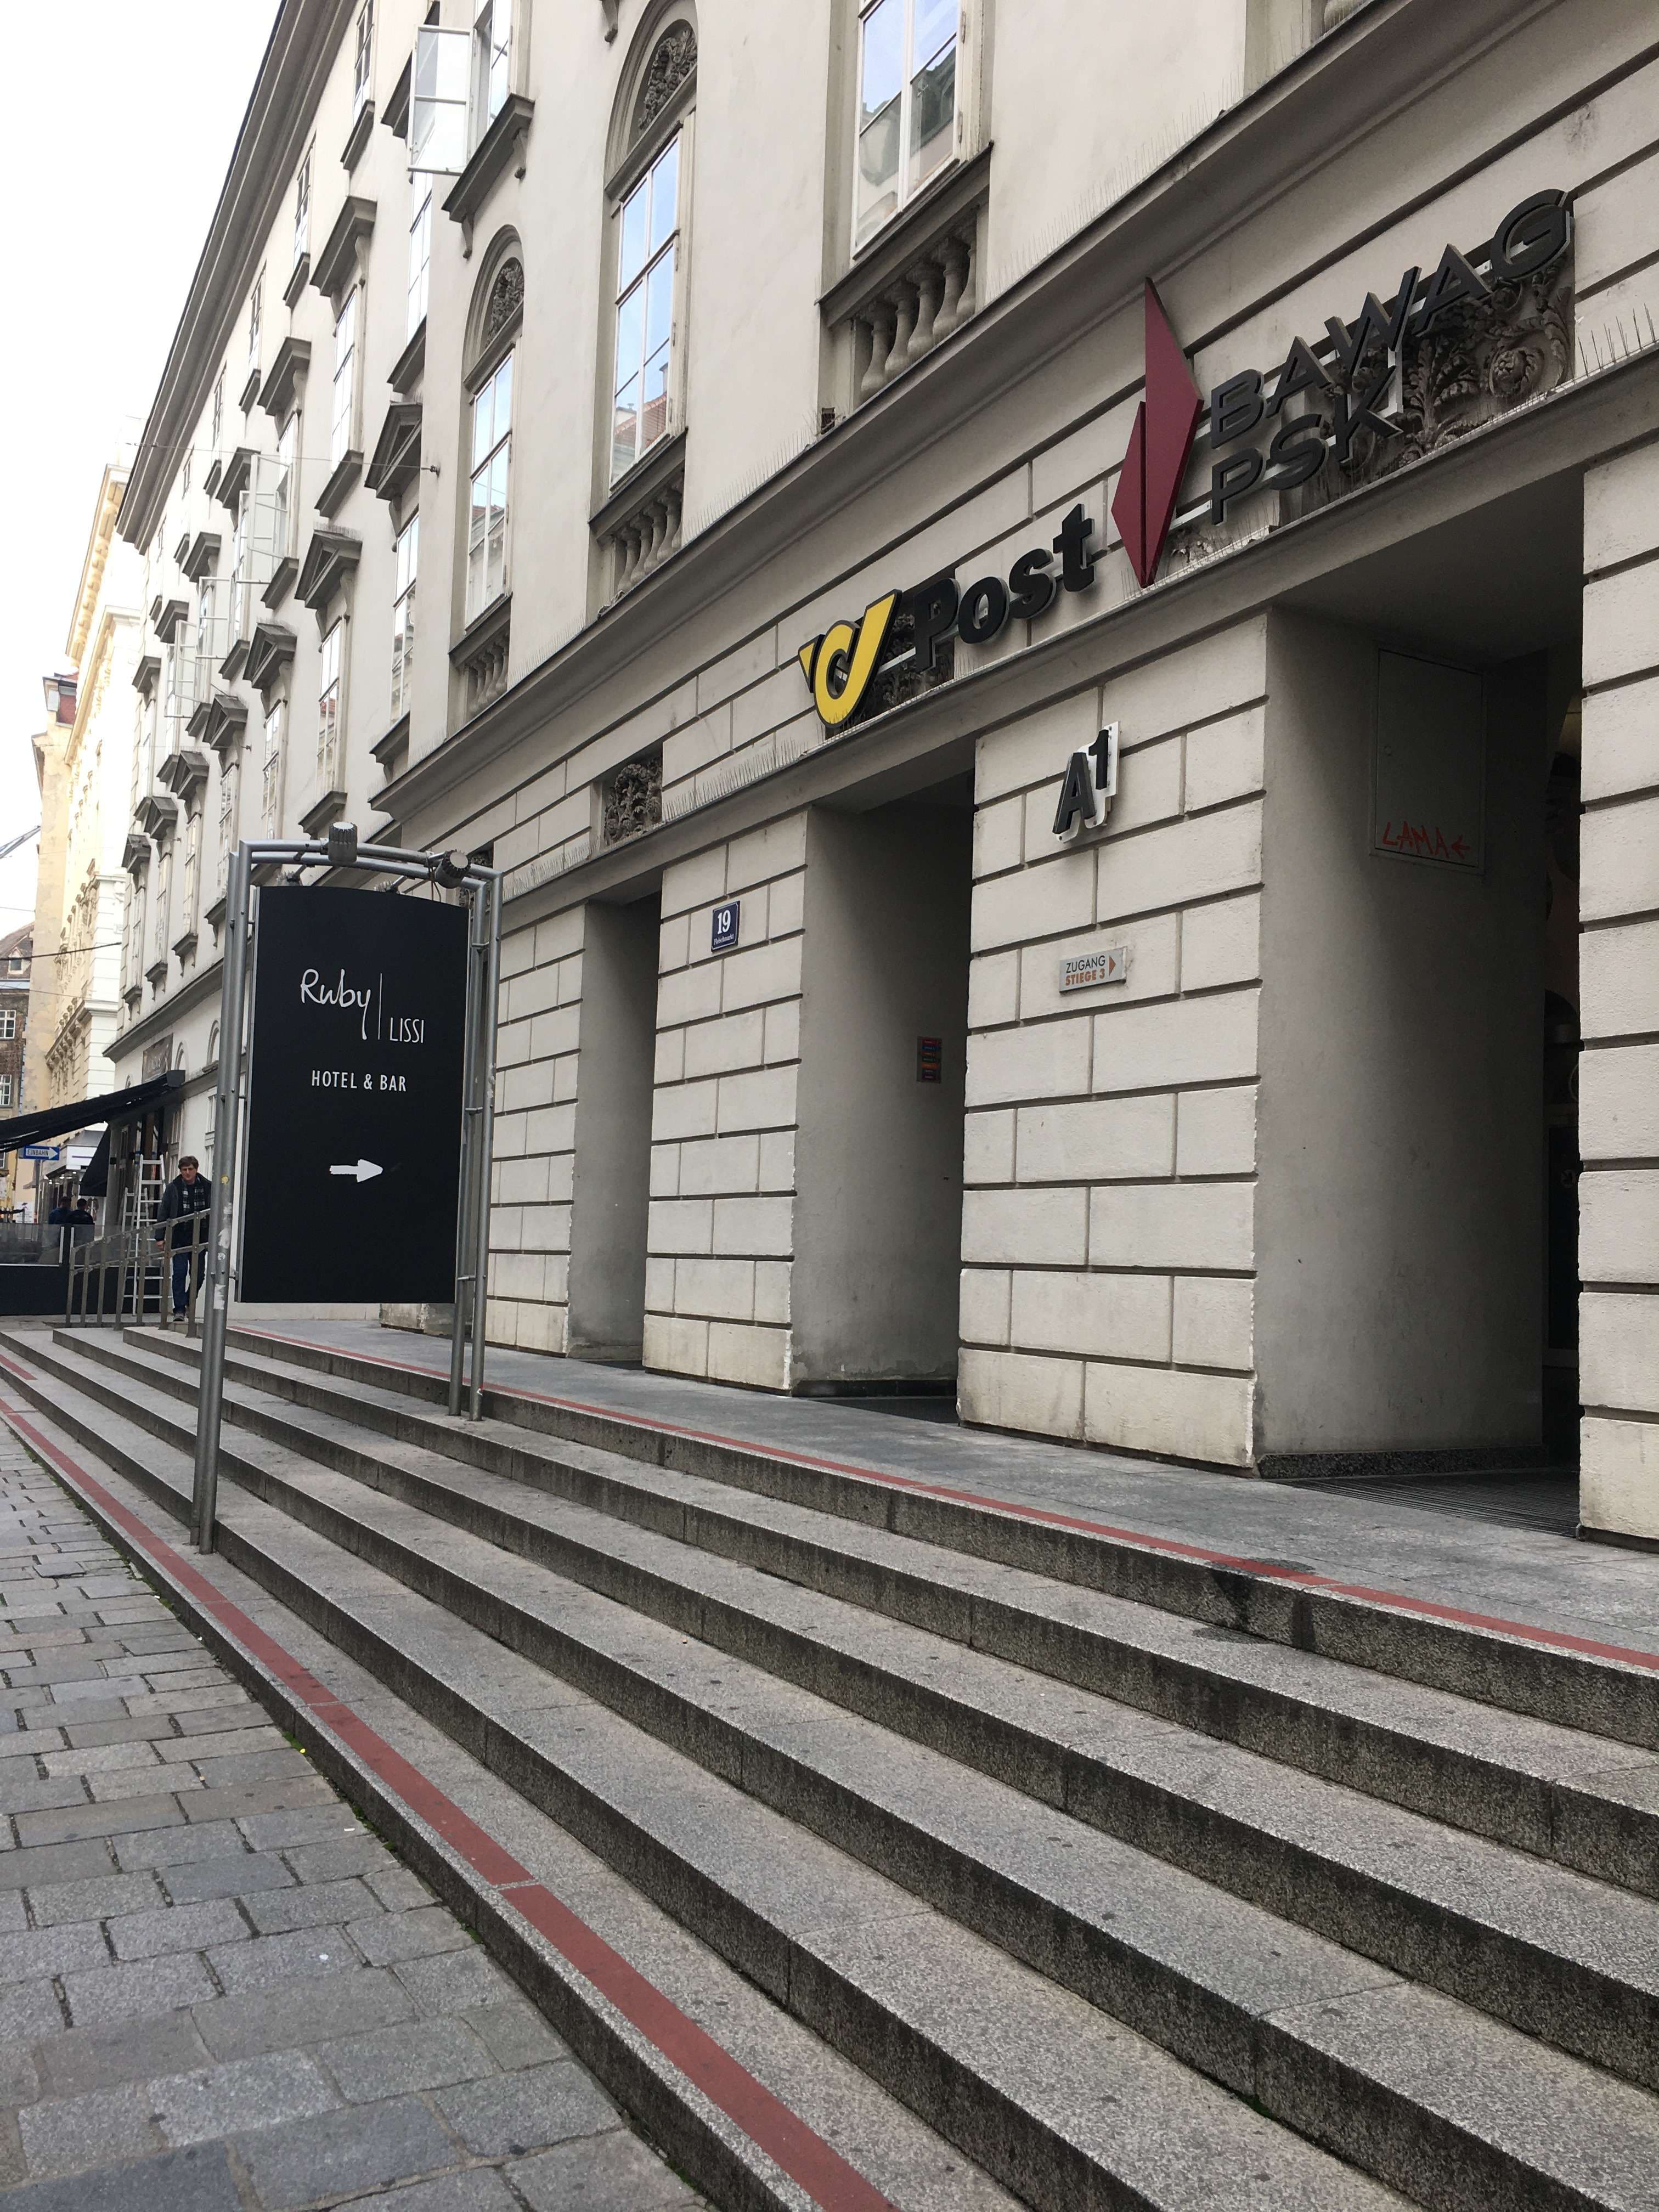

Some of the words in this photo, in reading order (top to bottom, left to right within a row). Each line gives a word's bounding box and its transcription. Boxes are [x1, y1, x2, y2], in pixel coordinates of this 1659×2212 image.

[1211, 188, 1573, 450] BAWAG
[1211, 365, 1403, 525] PSK
[913, 503, 1096, 674] Post
[1052, 729, 1110, 835] A1
[717, 910, 731, 935] 19
[1065, 969, 1097, 986] STIEGE
[1099, 968, 1105, 979] 3
[1066, 955, 1105, 974] ZUGANG
[300, 968, 371, 1041] Ruby
[390, 1017, 425, 1043] LISSI
[311, 1070, 358, 1089] HOTEL
[363, 1074, 373, 1090] &
[380, 1074, 407, 1092] BAR
